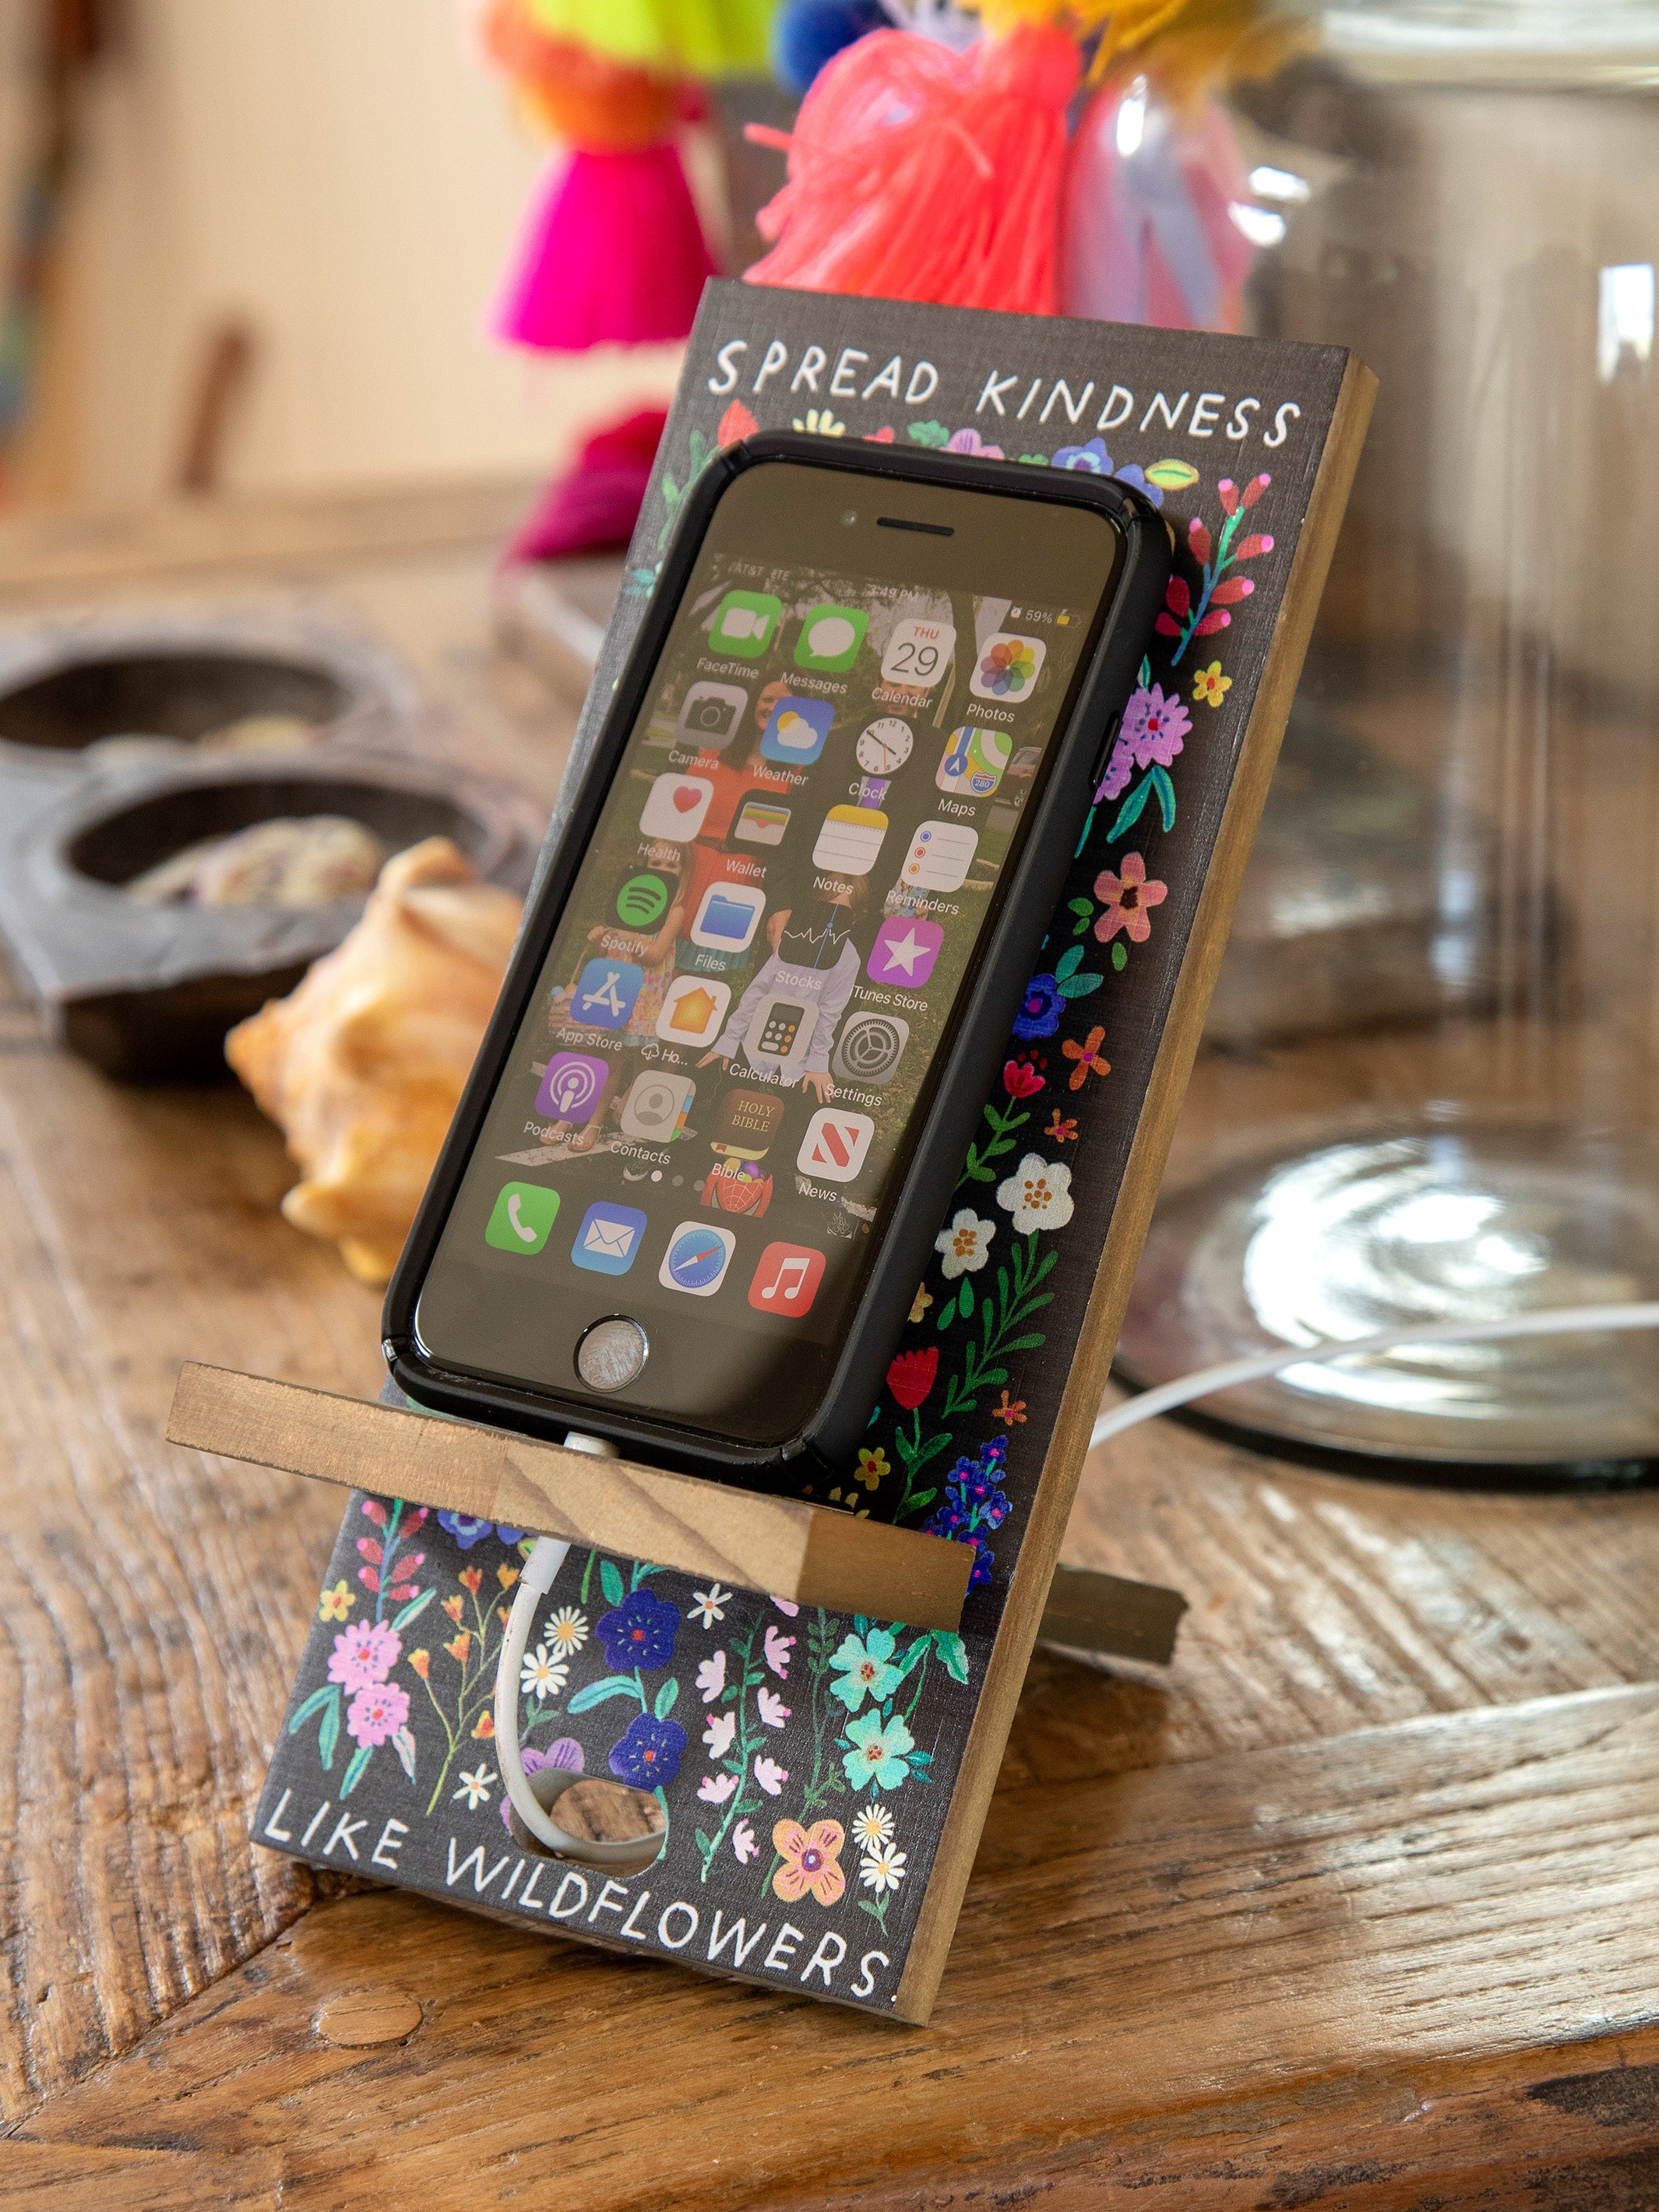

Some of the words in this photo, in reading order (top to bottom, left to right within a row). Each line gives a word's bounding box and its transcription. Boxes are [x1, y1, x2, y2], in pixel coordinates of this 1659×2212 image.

[708, 340, 938, 404] SPREAD
[975, 368, 1301, 448] KINDNESS
[1025, 609, 1053, 623] 59%
[913, 625, 940, 640] THU
[696, 656, 760, 680] FaceTime
[890, 642, 939, 676] 29
[780, 671, 848, 694] Messages
[872, 686, 933, 710] Calendar
[966, 703, 1016, 723] Photos
[668, 749, 720, 770] Camera
[753, 764, 809, 786] Weather
[974, 779, 990, 788] 280
[848, 783, 887, 801] Clock
[938, 798, 976, 817] Maps
[637, 841, 682, 862] Health
[726, 858, 767, 879] Wallet
[813, 875, 854, 895] Notes
[886, 889, 960, 915] Reminders
[601, 934, 648, 958] Spotify
[695, 954, 726, 971] Files
[775, 970, 822, 991] Stocks
[893, 994, 928, 1011] Store
[556, 1027, 586, 1047] App
[589, 1032, 622, 1051] Store
[729, 1062, 800, 1090] Calculator
[823, 1083, 882, 1108] Settings
[738, 1100, 774, 1118] HOLY
[524, 1121, 585, 1147] Podcasts
[731, 1115, 770, 1132] BIBLE
[611, 1140, 671, 1165] Contacts
[711, 1163, 745, 1182] Bible
[798, 1182, 837, 1202] News
[262, 1788, 410, 1869] LIKE
[445, 1837, 890, 1998] WILDFLOWERS
